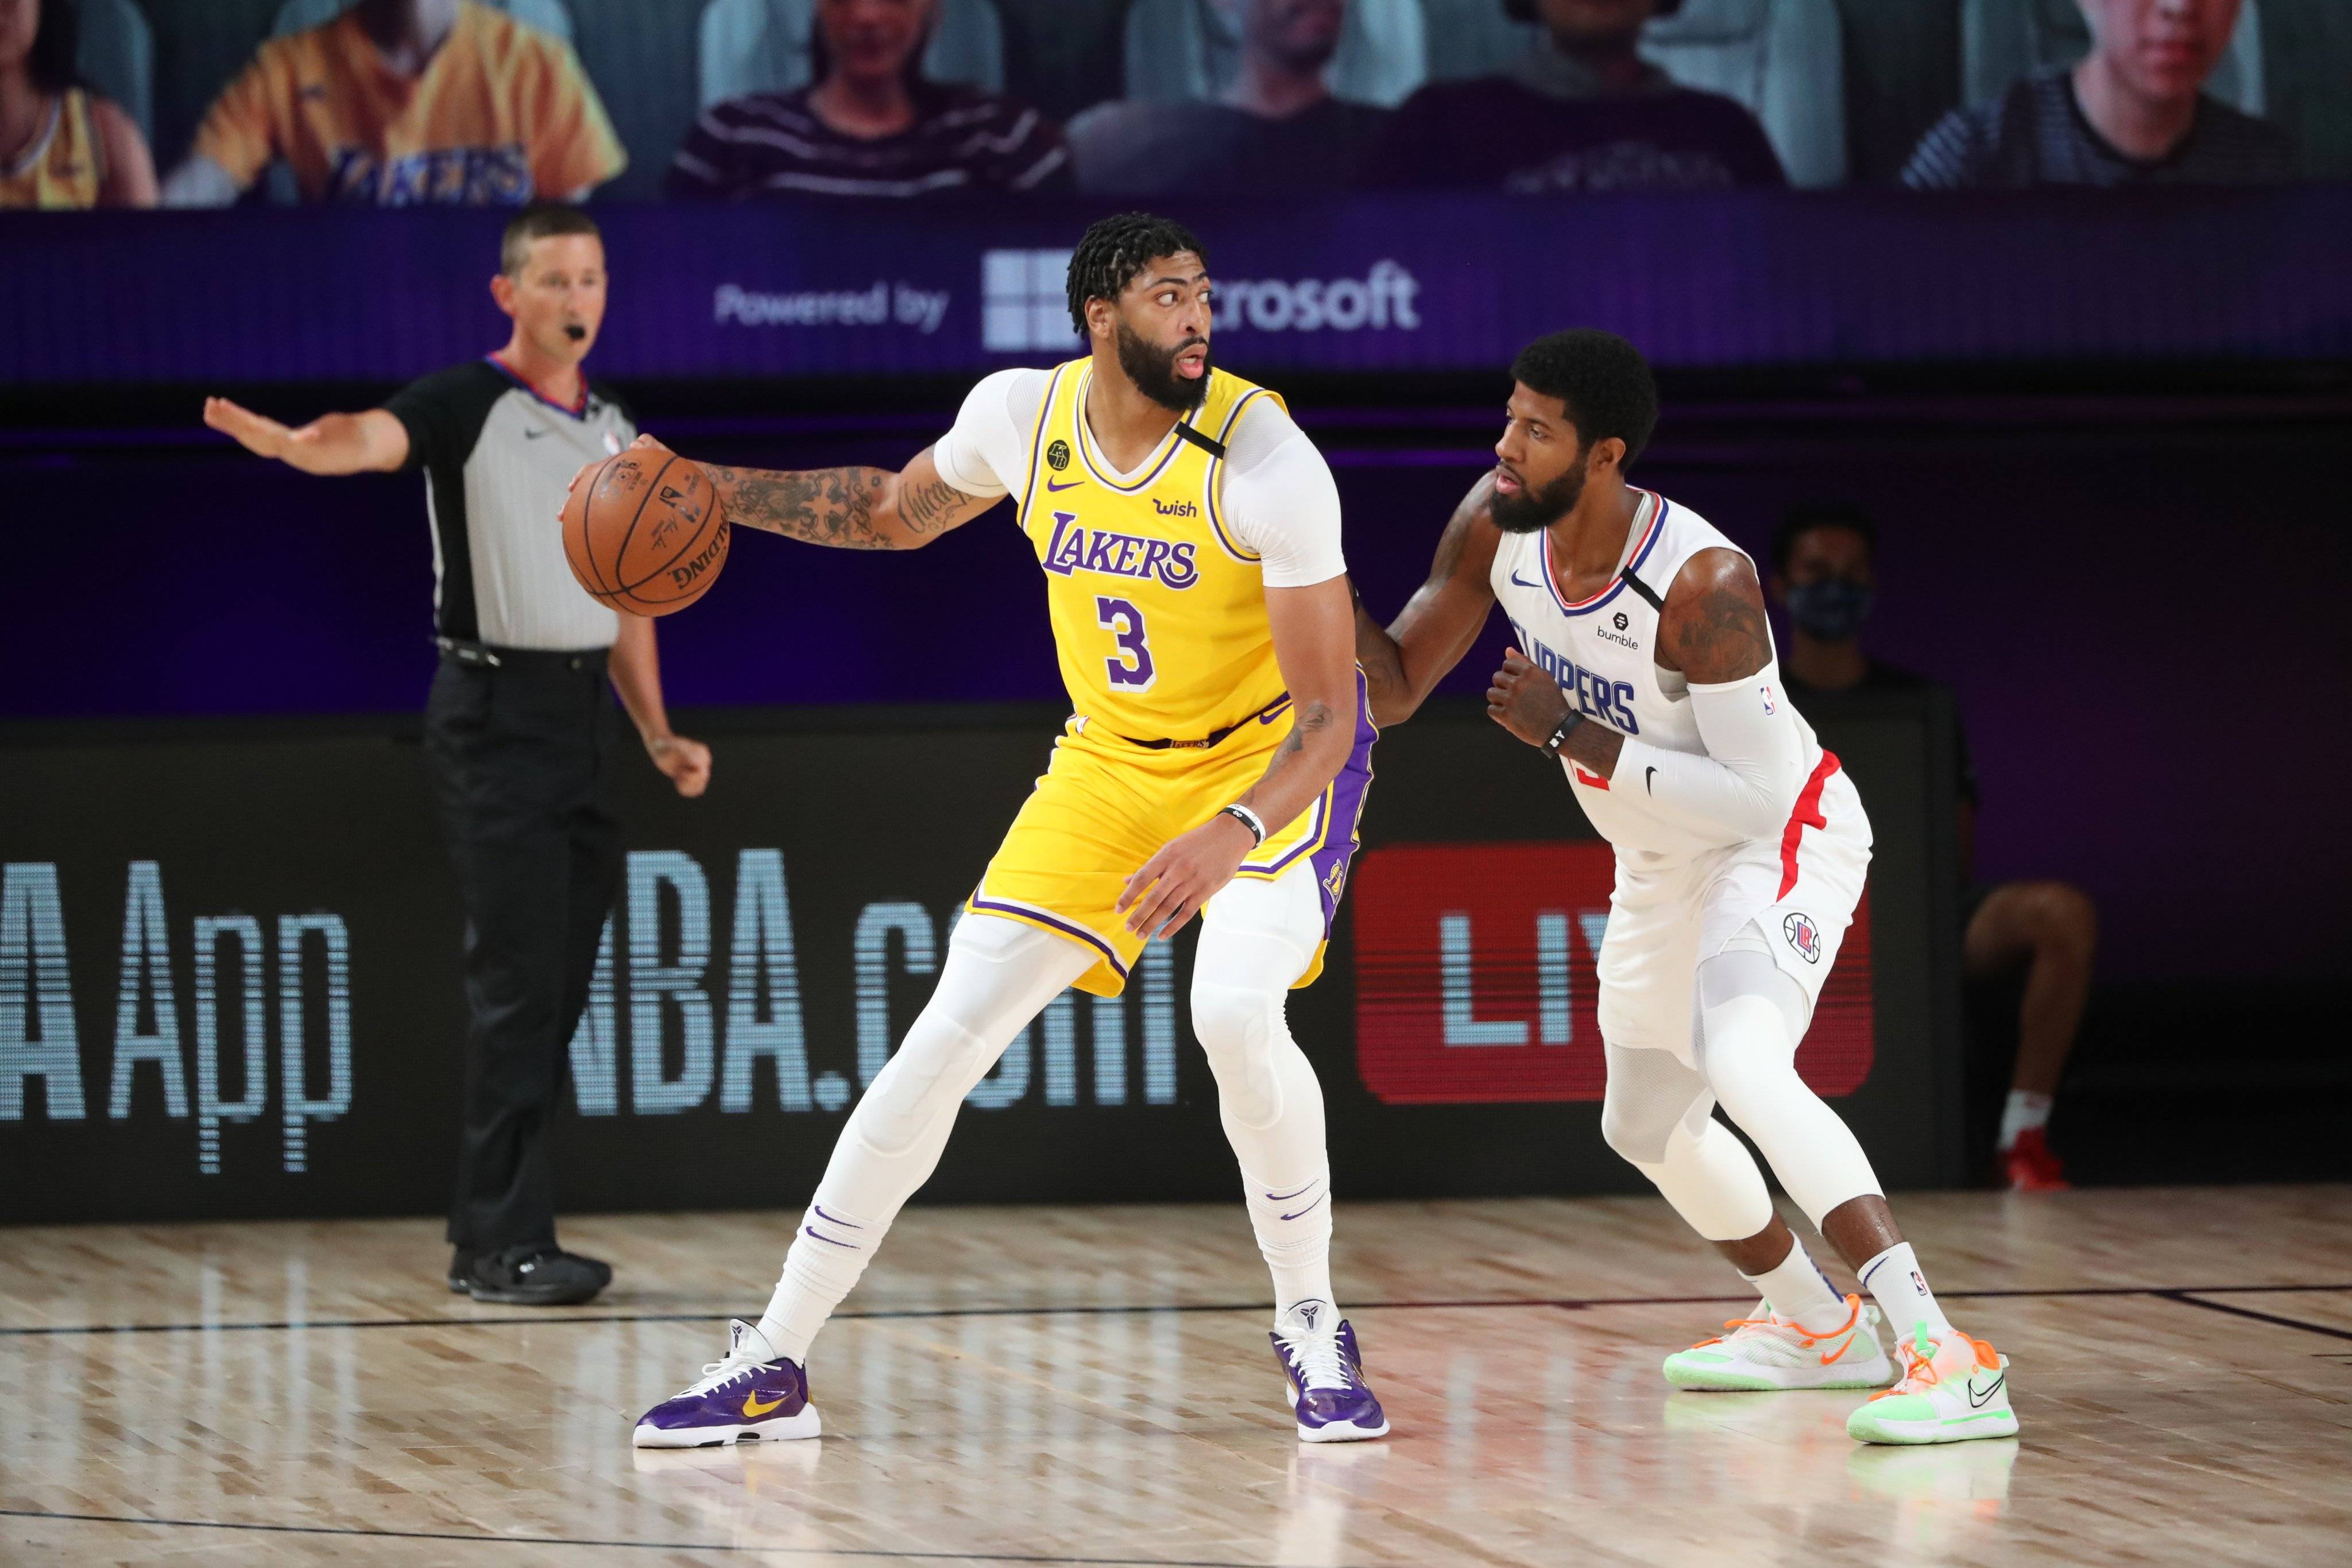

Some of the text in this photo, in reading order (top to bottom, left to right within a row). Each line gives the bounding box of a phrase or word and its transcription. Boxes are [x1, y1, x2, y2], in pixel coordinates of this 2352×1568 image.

[714, 281, 950, 333] Powered by
[1152, 498, 1197, 518] wish
[1042, 510, 1200, 591] LAKERS
[1094, 594, 1156, 694] 3
[1597, 626, 1638, 650] bumble
[109, 860, 352, 1174] App
